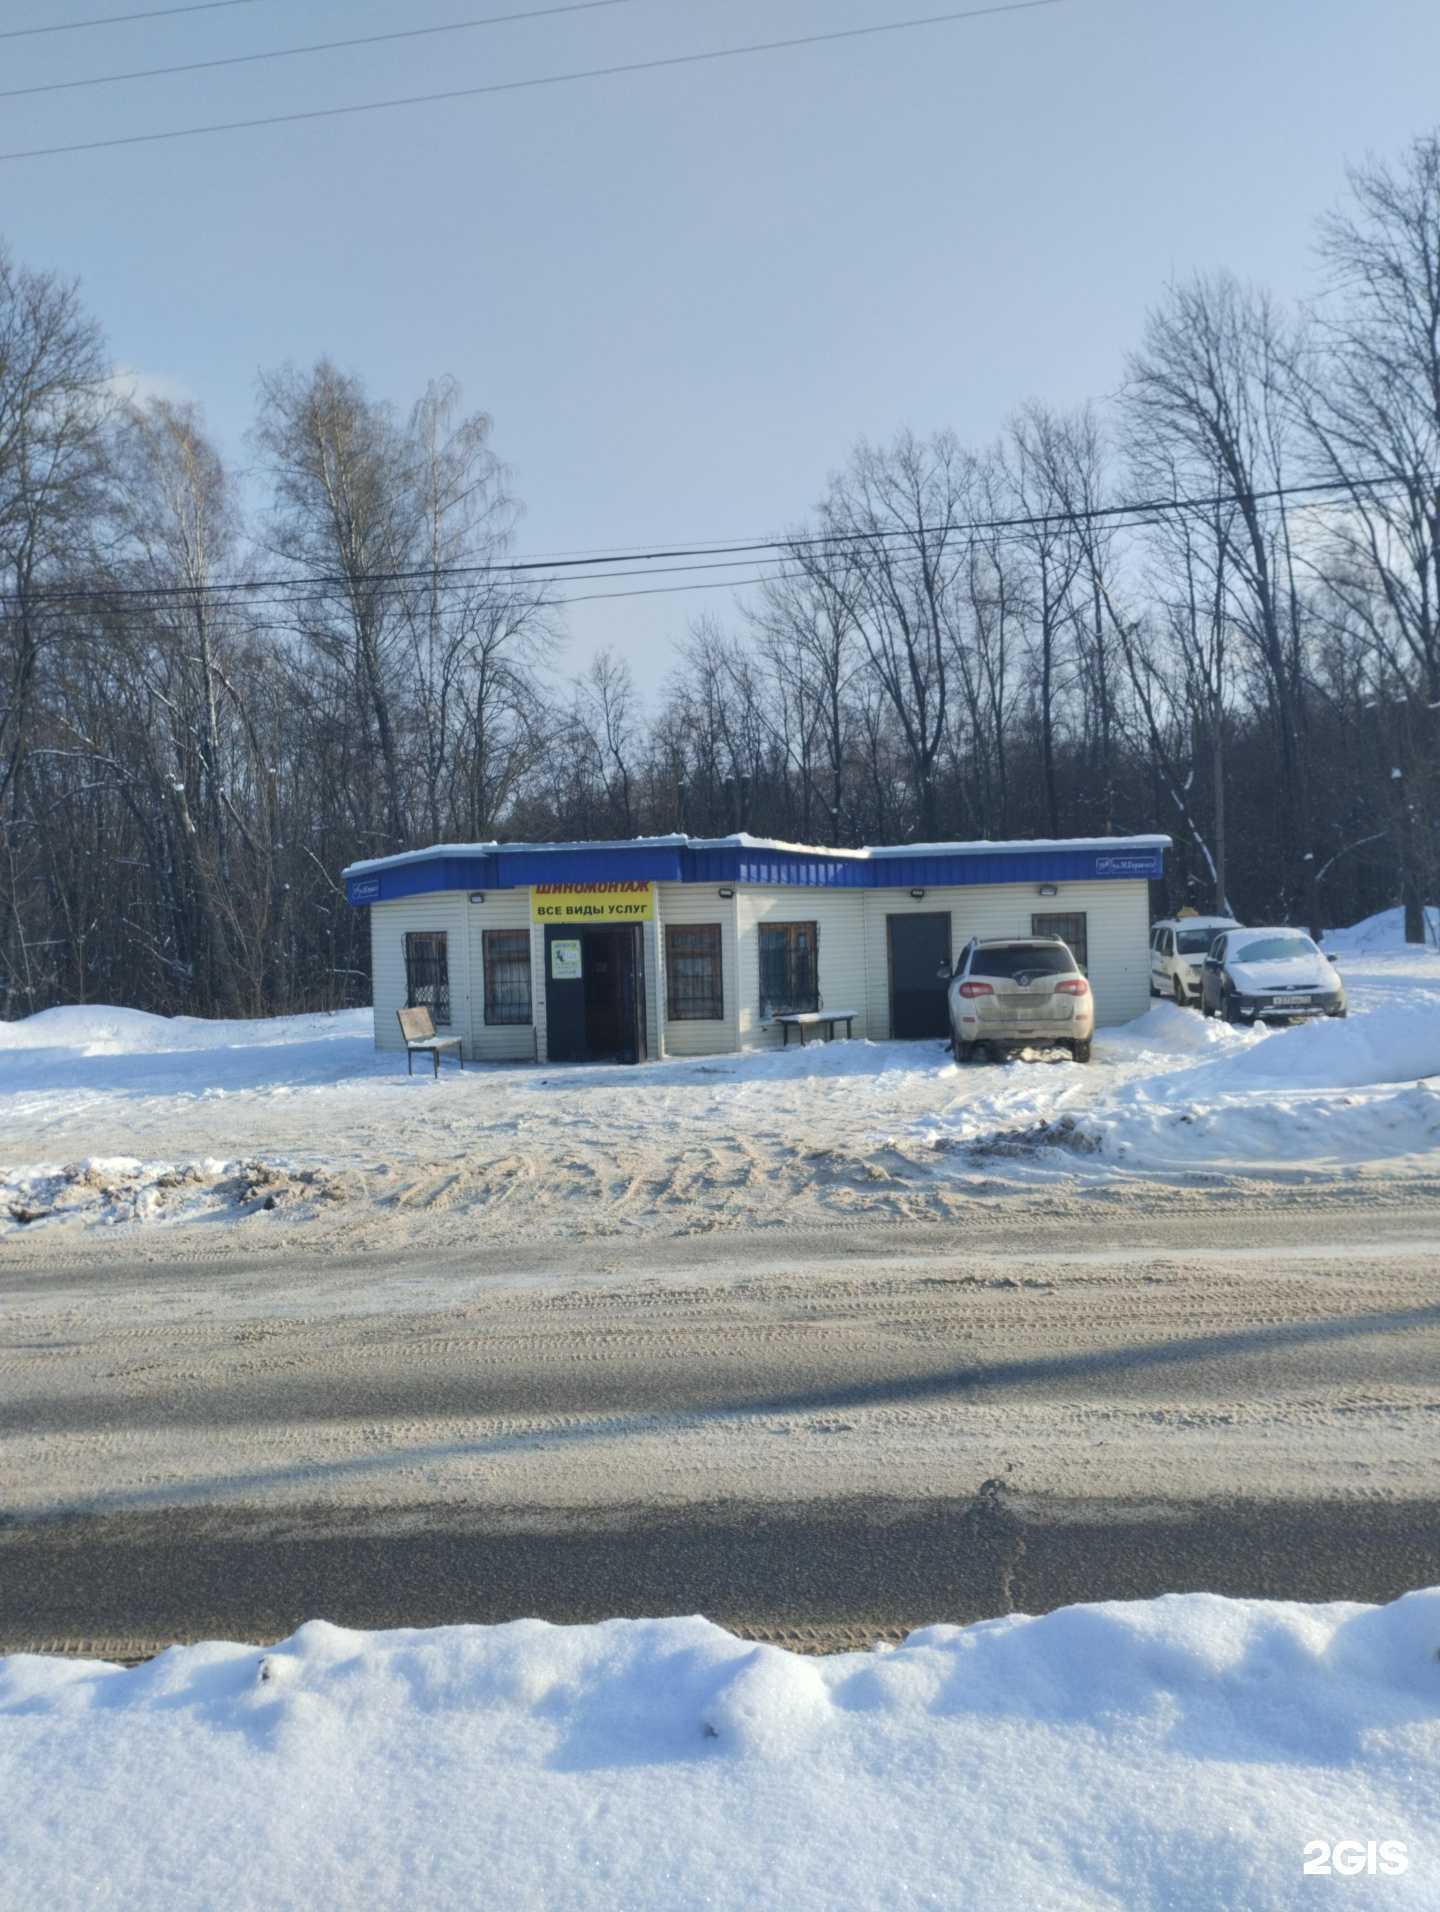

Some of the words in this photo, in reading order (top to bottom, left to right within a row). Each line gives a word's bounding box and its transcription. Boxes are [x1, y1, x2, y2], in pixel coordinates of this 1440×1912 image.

[535, 880, 649, 894] ШИНОМОНТАЖ
[537, 905, 562, 916] ВСЕ
[566, 905, 604, 916] ВИДЫ
[608, 904, 648, 914] УСЛУГ
